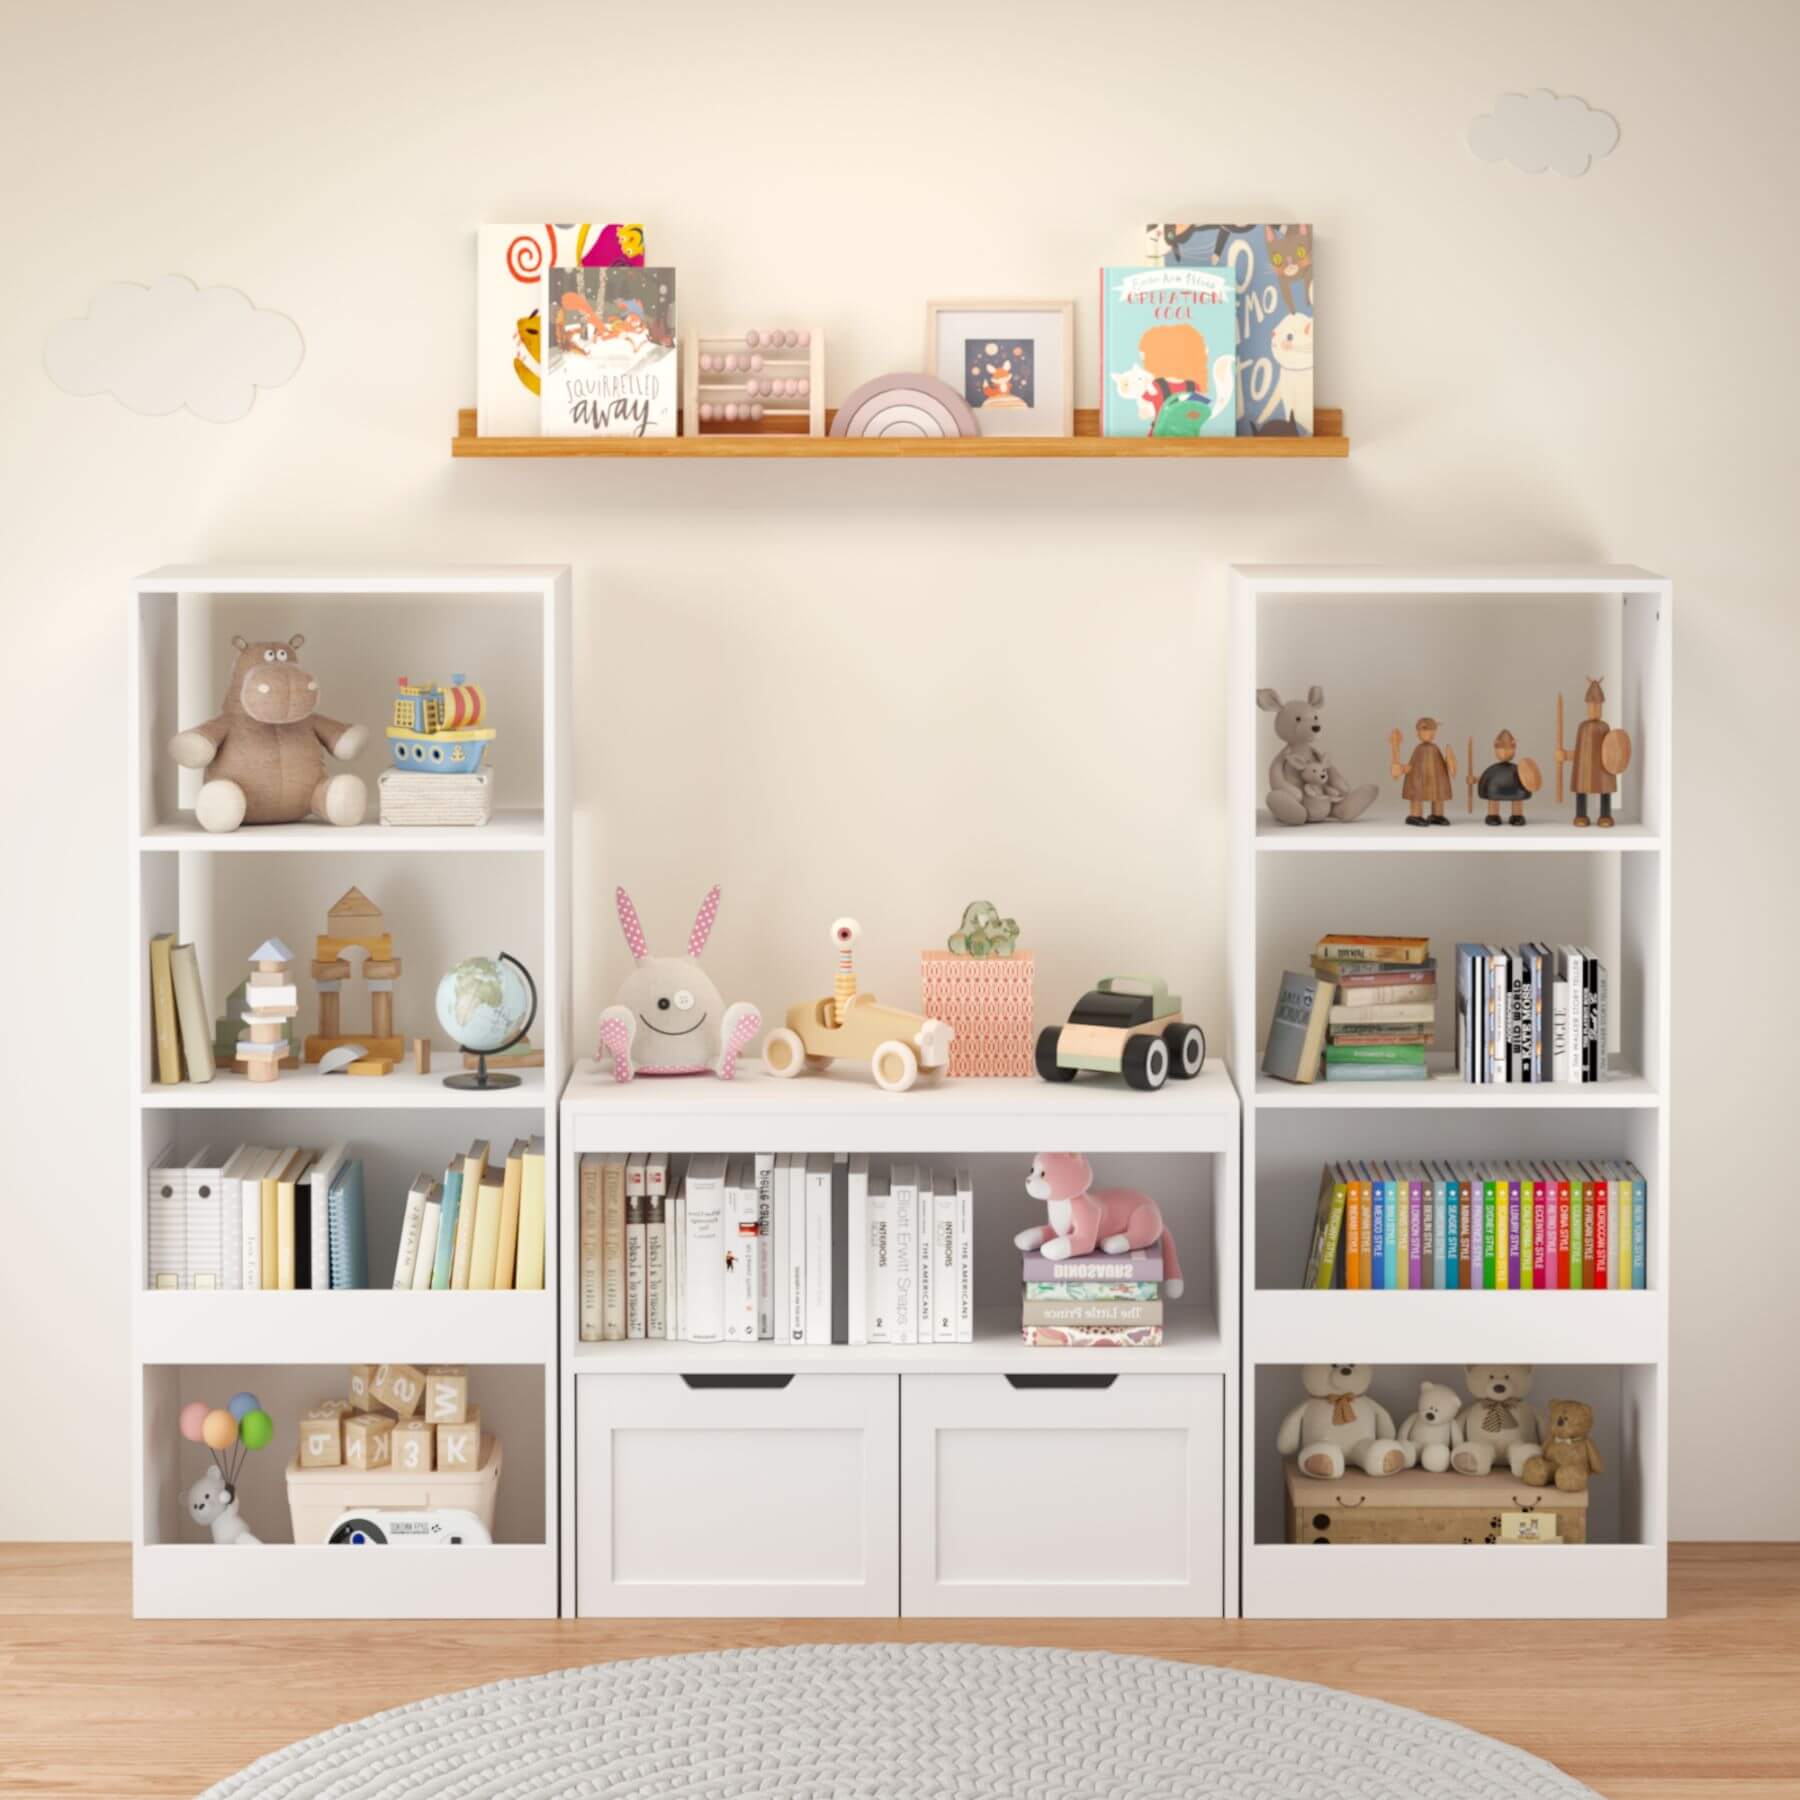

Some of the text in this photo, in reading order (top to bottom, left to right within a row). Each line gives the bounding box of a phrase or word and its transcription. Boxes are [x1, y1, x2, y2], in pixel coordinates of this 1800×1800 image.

[566, 374, 660, 404] SQUIRRELLED
[569, 398, 658, 438] away
[1513, 979, 1521, 1054] WILD WORLD
[1522, 983, 1532, 1060] KATE MOSS
[1554, 1007, 1567, 1056] VOGUE
[879, 1221, 887, 1268] INTERIORS
[944, 1221, 952, 1268] INTERIORS
[1374, 1205, 1383, 1256] MEXICO STYLE
[1411, 1205, 1420, 1260] LONDON STYLE
[1424, 1233, 1433, 1254] STYLE
[1448, 1237, 1456, 1259] STYLE
[1486, 1235, 1494, 1256] STYLE
[1510, 1235, 1519, 1256] STYLE
[1559, 1205, 1568, 1251] CHINA STYLE
[1460, 1238, 1470, 1260] STYLE
[1534, 1247, 1544, 1269] STYLE
[1584, 1238, 1592, 1260] STYLE
[1596, 1249, 1606, 1272] STYLE
[895, 1278, 911, 1325] Snaps
